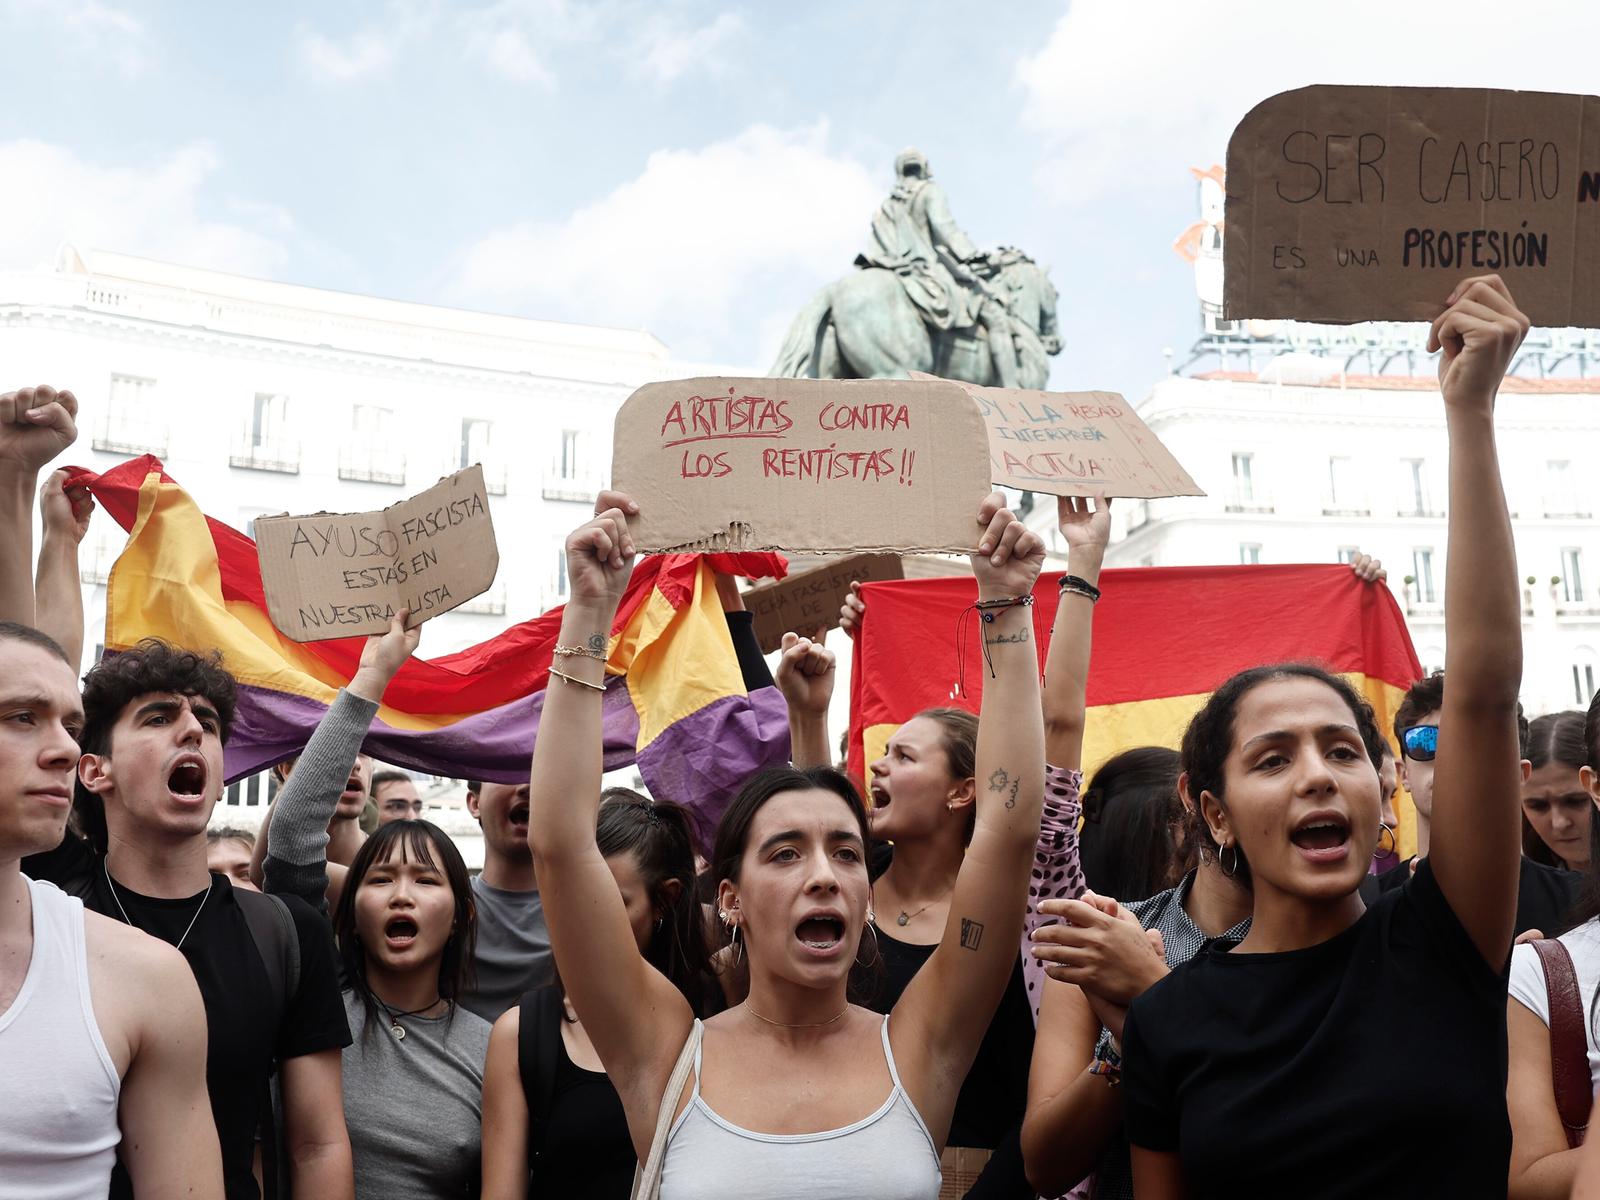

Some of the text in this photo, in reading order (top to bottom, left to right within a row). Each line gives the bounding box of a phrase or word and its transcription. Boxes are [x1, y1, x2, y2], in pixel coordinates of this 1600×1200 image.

[1275, 130, 1386, 204] SER
[1418, 136, 1560, 204] CASERO
[1272, 220, 1548, 269] ES UNA PROFESIÓN
[818, 400, 910, 431] CONTRA
[1018, 401, 1064, 424] LA
[680, 450, 733, 479] LOS
[290, 492, 484, 559] AYUSO FASCISTA
[412, 550, 438, 576] EN
[299, 584, 453, 629] NUESTRA LISTA
[800, 599, 823, 617] DE
